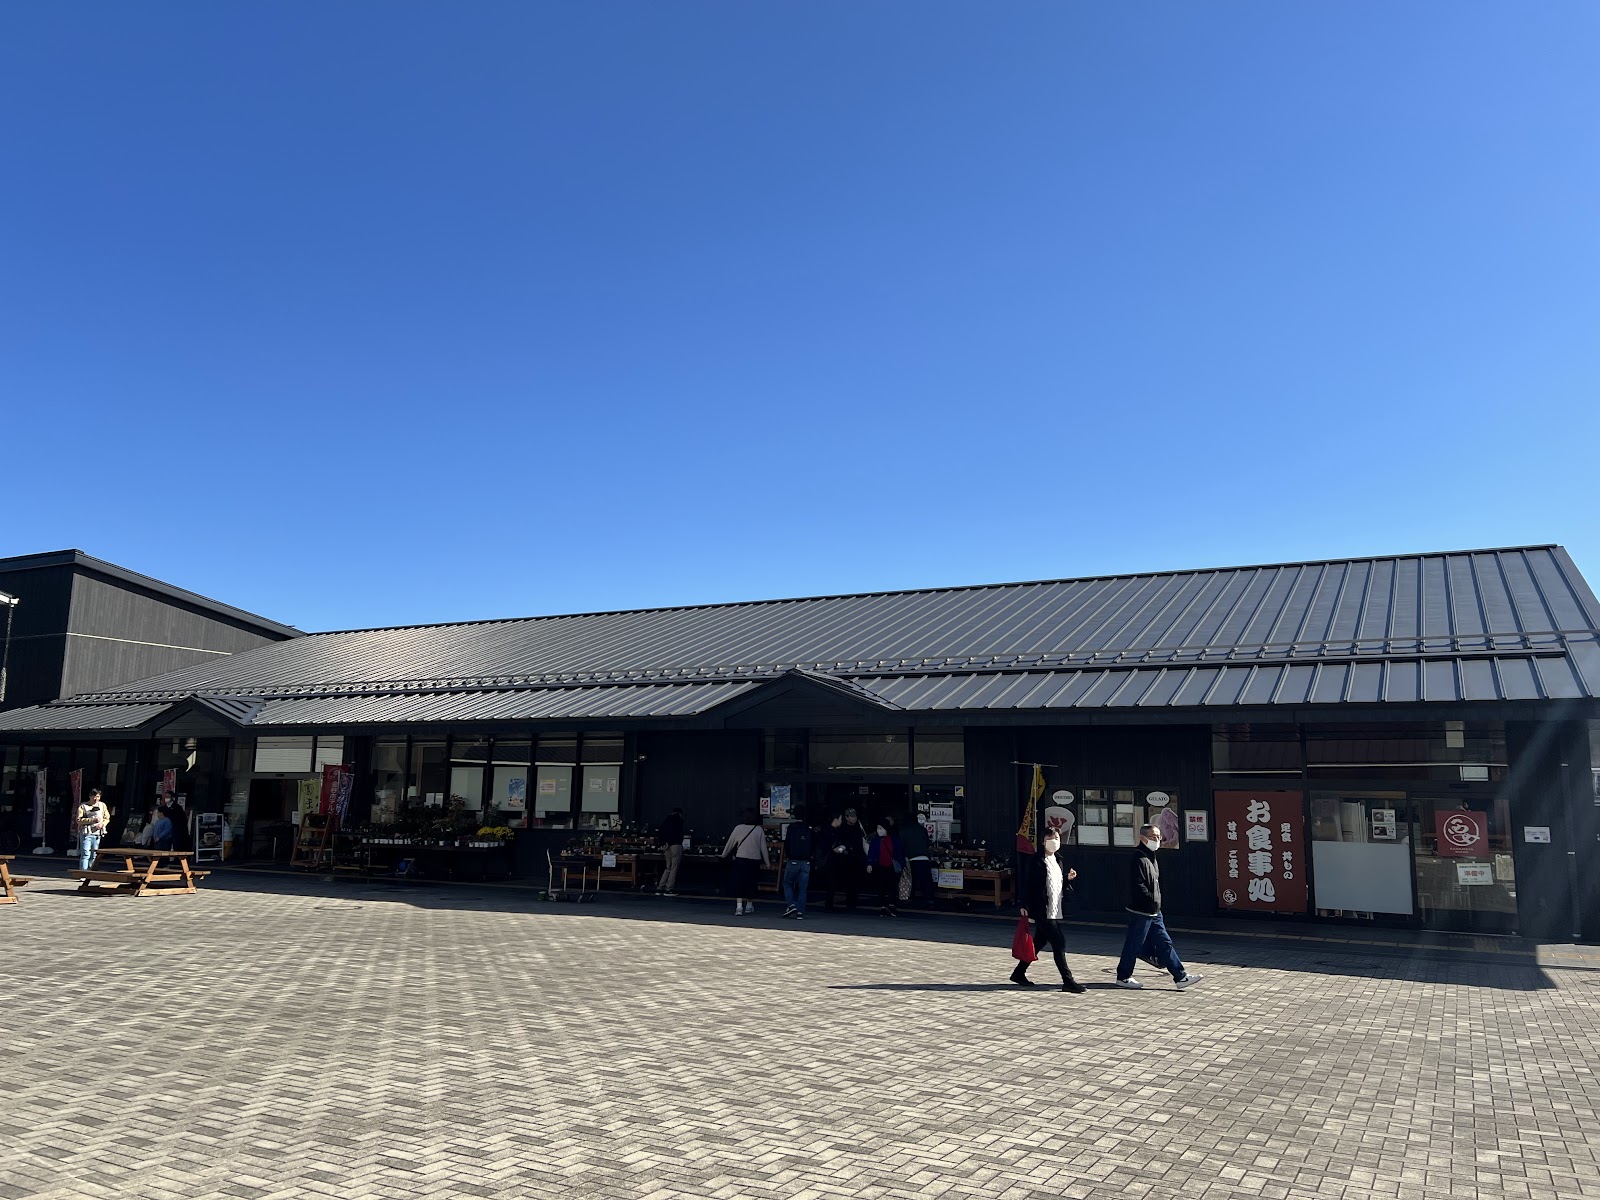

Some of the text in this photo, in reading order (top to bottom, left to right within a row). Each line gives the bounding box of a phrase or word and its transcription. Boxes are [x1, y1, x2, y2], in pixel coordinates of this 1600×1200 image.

[1246, 799, 1275, 902] お食事処
[1282, 851, 1294, 880] 丼もの
